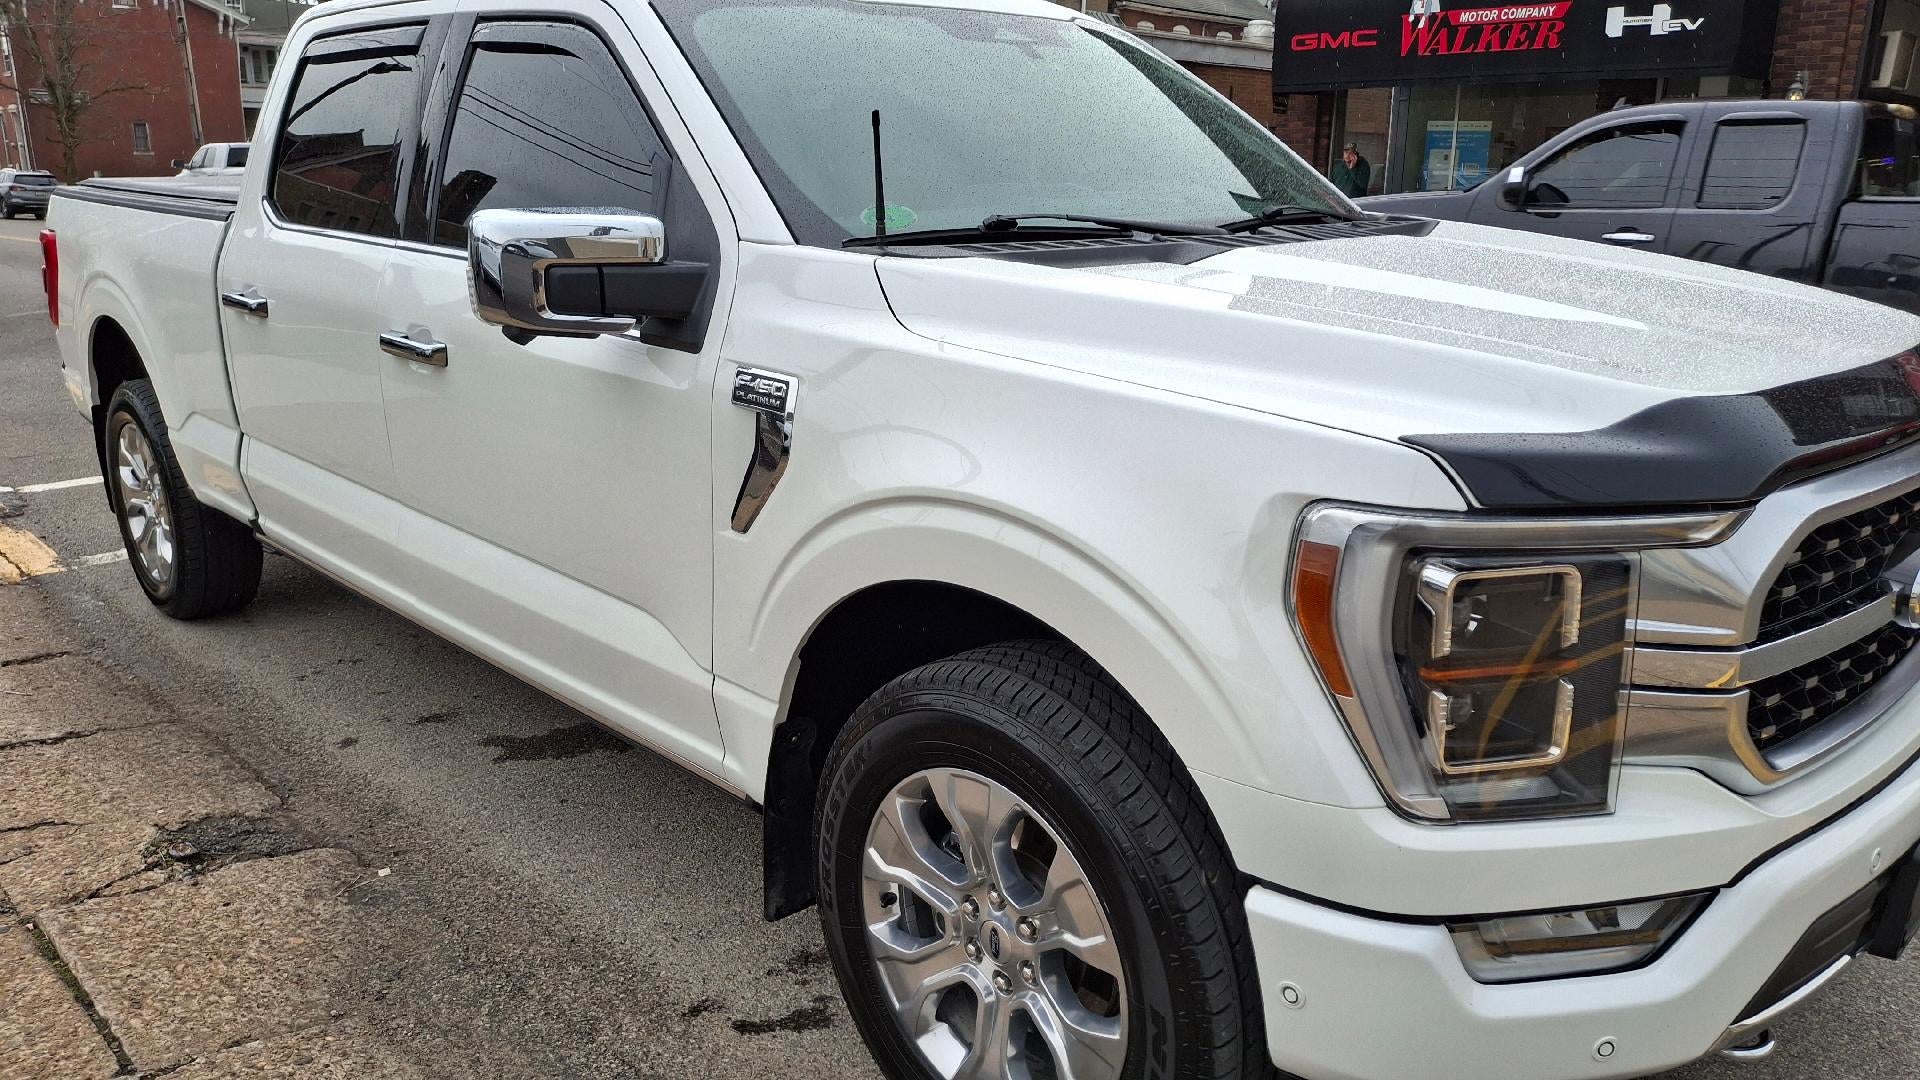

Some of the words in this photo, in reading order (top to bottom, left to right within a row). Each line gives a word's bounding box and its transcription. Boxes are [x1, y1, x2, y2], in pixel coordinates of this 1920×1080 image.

[1460, 10, 1499, 22] MOTOR
[1501, 6, 1557, 19] COMPANY
[1291, 29, 1377, 51] GMC
[1401, 12, 1565, 57] WALKER
[736, 390, 781, 407] PLATINUM
